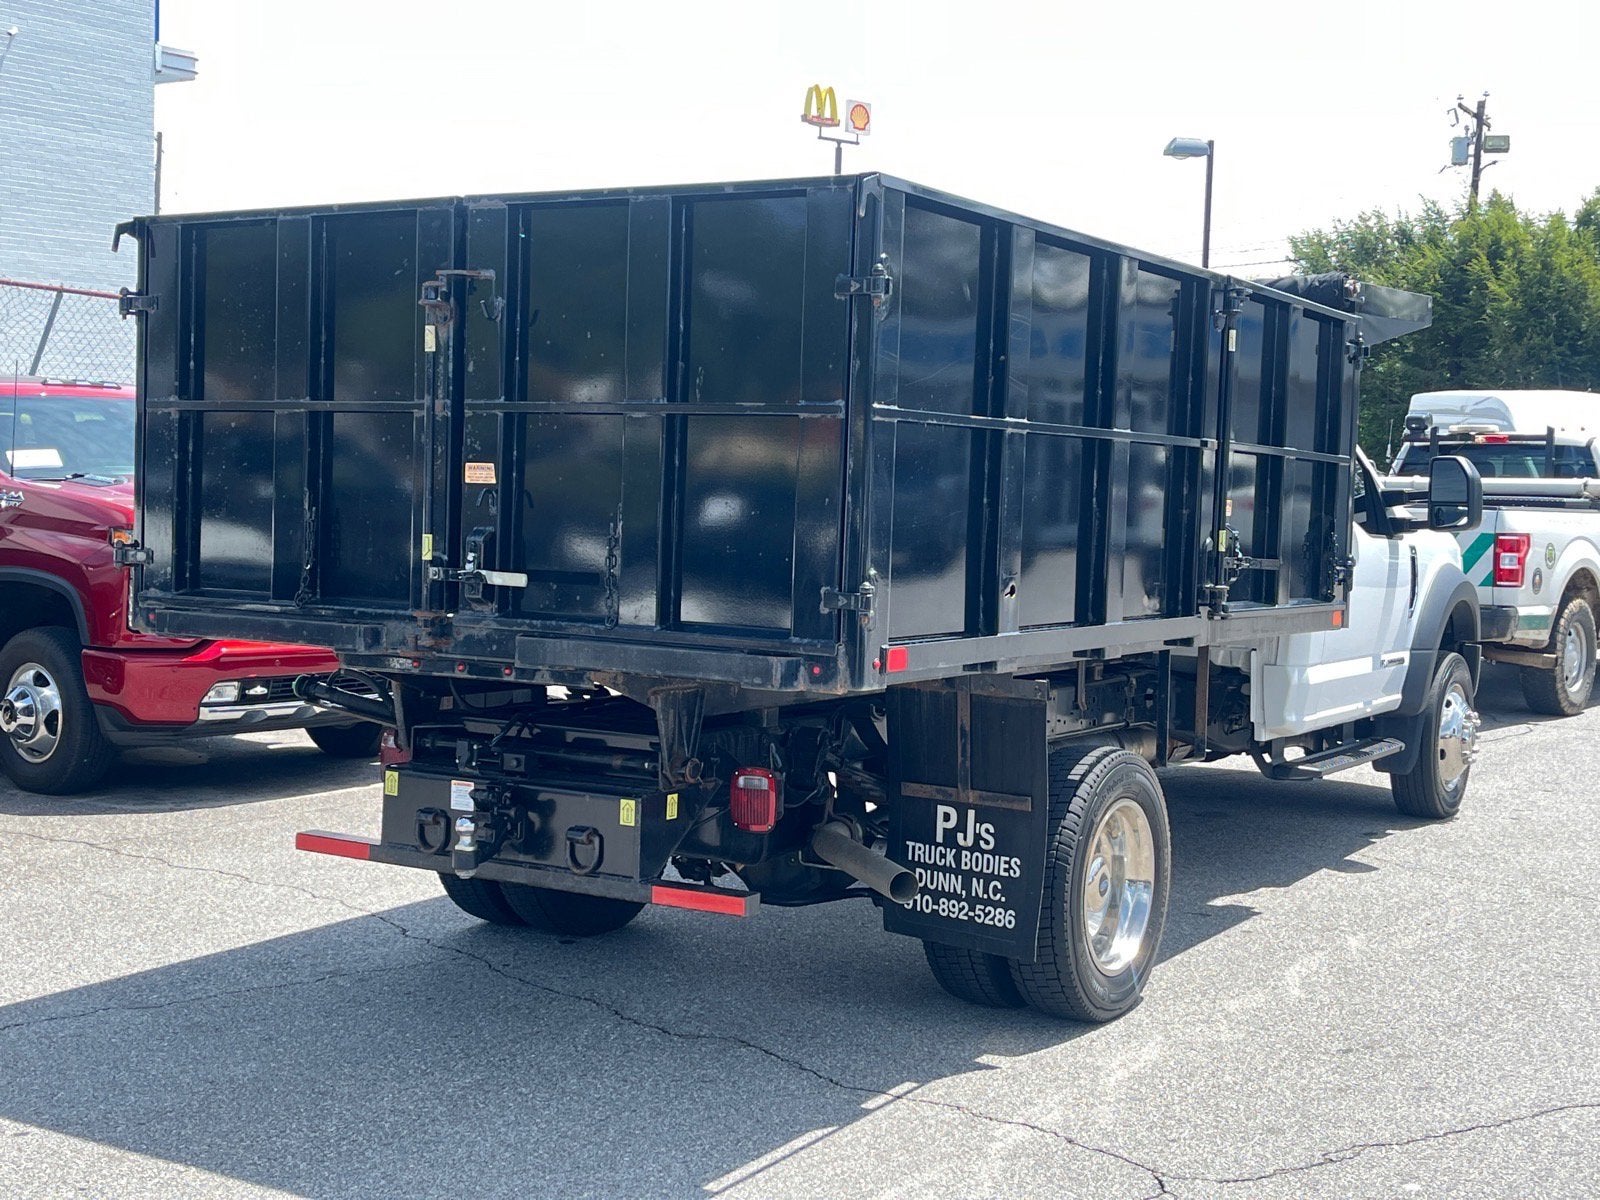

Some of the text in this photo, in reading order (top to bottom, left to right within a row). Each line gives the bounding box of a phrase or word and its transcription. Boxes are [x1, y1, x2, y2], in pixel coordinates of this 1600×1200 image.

[905, 840, 1021, 878] TRUCK BODIES
[915, 867, 1006, 902] DUNN, N.C.
